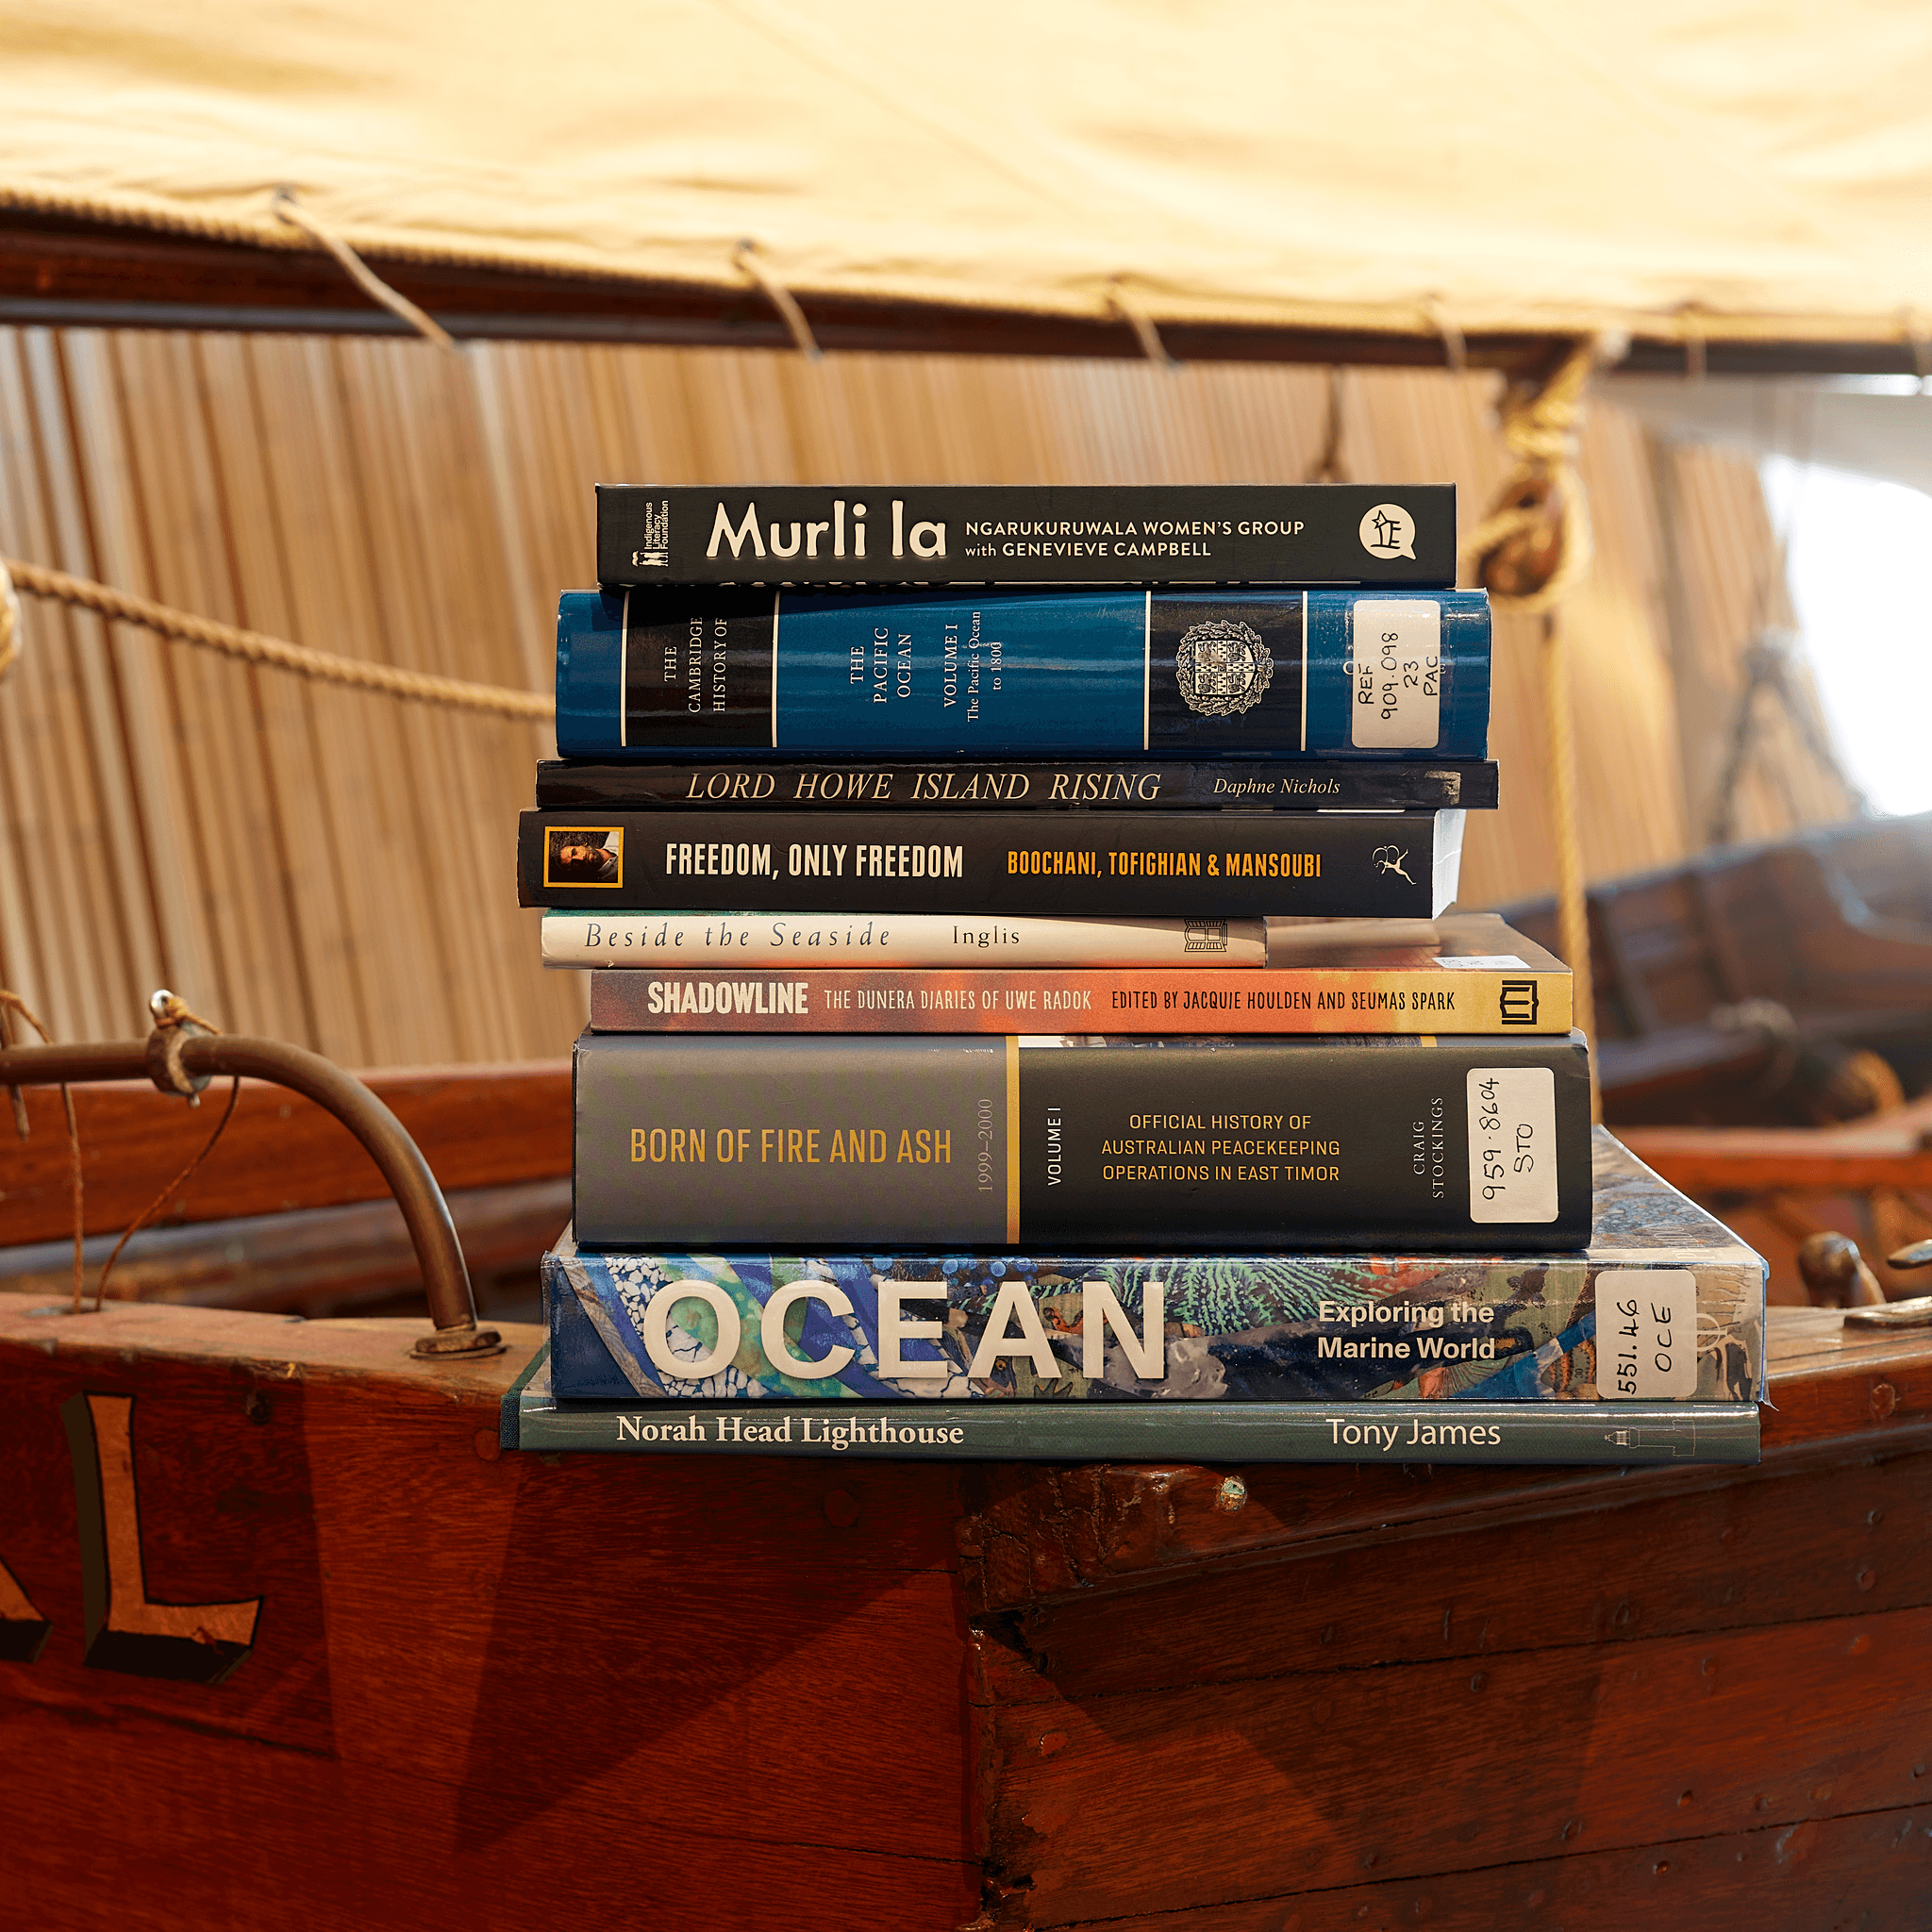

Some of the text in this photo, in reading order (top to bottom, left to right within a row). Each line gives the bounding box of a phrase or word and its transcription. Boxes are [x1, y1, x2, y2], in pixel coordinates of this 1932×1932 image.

[643, 502, 655, 550] Indigenous
[652, 514, 662, 550] Literacy
[659, 500, 669, 550] Foundation
[706, 500, 946, 559] Murli la
[966, 521, 1305, 536] NGARUKURUWALA WOMEN’S GROUP
[965, 541, 1211, 557] with GENEVIEVE CAMPBELL
[664, 646, 677, 682] THE
[688, 617, 703, 713] CAMBRIDGE
[713, 617, 727, 712] HISTORY OF
[850, 645, 865, 685] THE
[873, 627, 890, 704] PACIFIC
[896, 633, 912, 698] OCEAN
[943, 635, 958, 708] VOLUME
[966, 610, 981, 723] The Pacific Ocean
[990, 641, 1002, 691] to 1800
[1380, 632, 1399, 720] 909.098
[1403, 660, 1419, 689] 23
[1423, 656, 1439, 696] PAC
[1357, 663, 1374, 705] REF
[685, 773, 1161, 801] LORD HOWE ISLAND RISING
[1212, 777, 1340, 797] Daphne Nichols
[666, 842, 963, 880] FREEDOM, ONLY FREEDOM
[1008, 850, 1321, 878] BOOCHANI, TOFIGHIAN & MANSOUBI
[584, 921, 890, 947] Beside the Seaside
[953, 925, 1020, 949] Inglis
[647, 981, 808, 1014] SHADOWLINE
[824, 990, 1091, 1010] THE DUNERA DIARIES OF UWE RADOK
[1111, 991, 1456, 1011] EDITED BY JACQUIE HOULDEN AND SEUMAS SPARK
[1129, 1114, 1311, 1130] OFFICIAL HISTORY OF
[631, 1128, 951, 1164] BORN OF FIRE AND ASH
[1047, 1118, 1062, 1186] VOLUME
[1101, 1140, 1340, 1156] AUSTRALIAN PEACEKEEPING
[1413, 1121, 1425, 1175] CRAIG
[1431, 1097, 1444, 1199] STOCKINGS
[1513, 1124, 1534, 1173] STO
[1103, 1165, 1340, 1181] OPERATIONS IN EAST TIMOR
[643, 1280, 1165, 1379] OCEAN
[1316, 1297, 1495, 1330] Exploring the
[1316, 1335, 1496, 1361] Marine World
[1616, 1299, 1640, 1394] 551.46
[1651, 1303, 1672, 1372] OCE
[616, 1414, 964, 1451] Norah Head Lighthouse
[1324, 1414, 1501, 1452] Tony James
